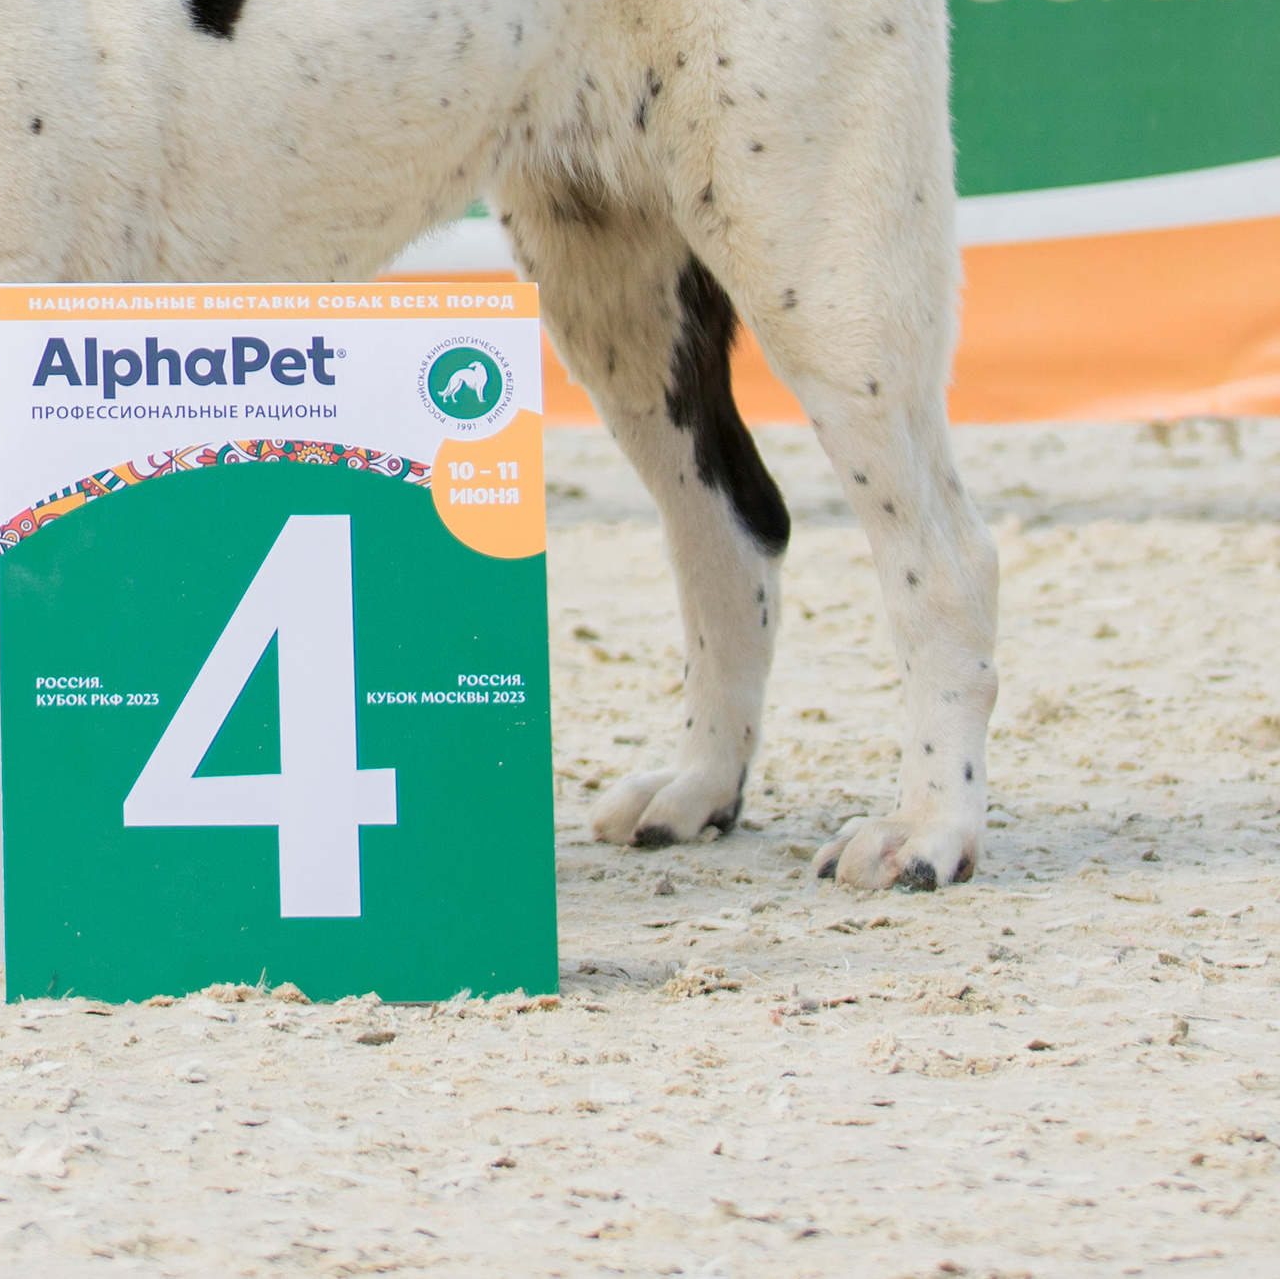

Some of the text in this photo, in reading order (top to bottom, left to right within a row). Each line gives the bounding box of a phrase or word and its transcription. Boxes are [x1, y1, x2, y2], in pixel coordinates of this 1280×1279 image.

[28, 294, 514, 312] НАЦИОНАЛЬНЫЕ ВЫСТАВКИ СОБАК ВСЕХ ПОРОД
[417, 336, 514, 423] РОССИЙСКАЯ КИНОЛОГИЧЕСКАЯ ФЕДЕРАЦИЯ
[32, 404, 337, 421] ПРОФЕССИОНАЛЬНЫЕ РАЦИОНЫ
[457, 422, 477, 430] 1991
[448, 461, 474, 480] 10
[497, 461, 518, 480] 11
[450, 487, 519, 504] ИЮНЯ
[36, 677, 103, 689] РОССИЯ.
[458, 674, 525, 686] РОССИЯ.
[36, 693, 159, 706] КУБОК РКФ 2023
[367, 691, 525, 704] КУБОК МОСКВЫ 2023
[123, 514, 398, 918] 4
